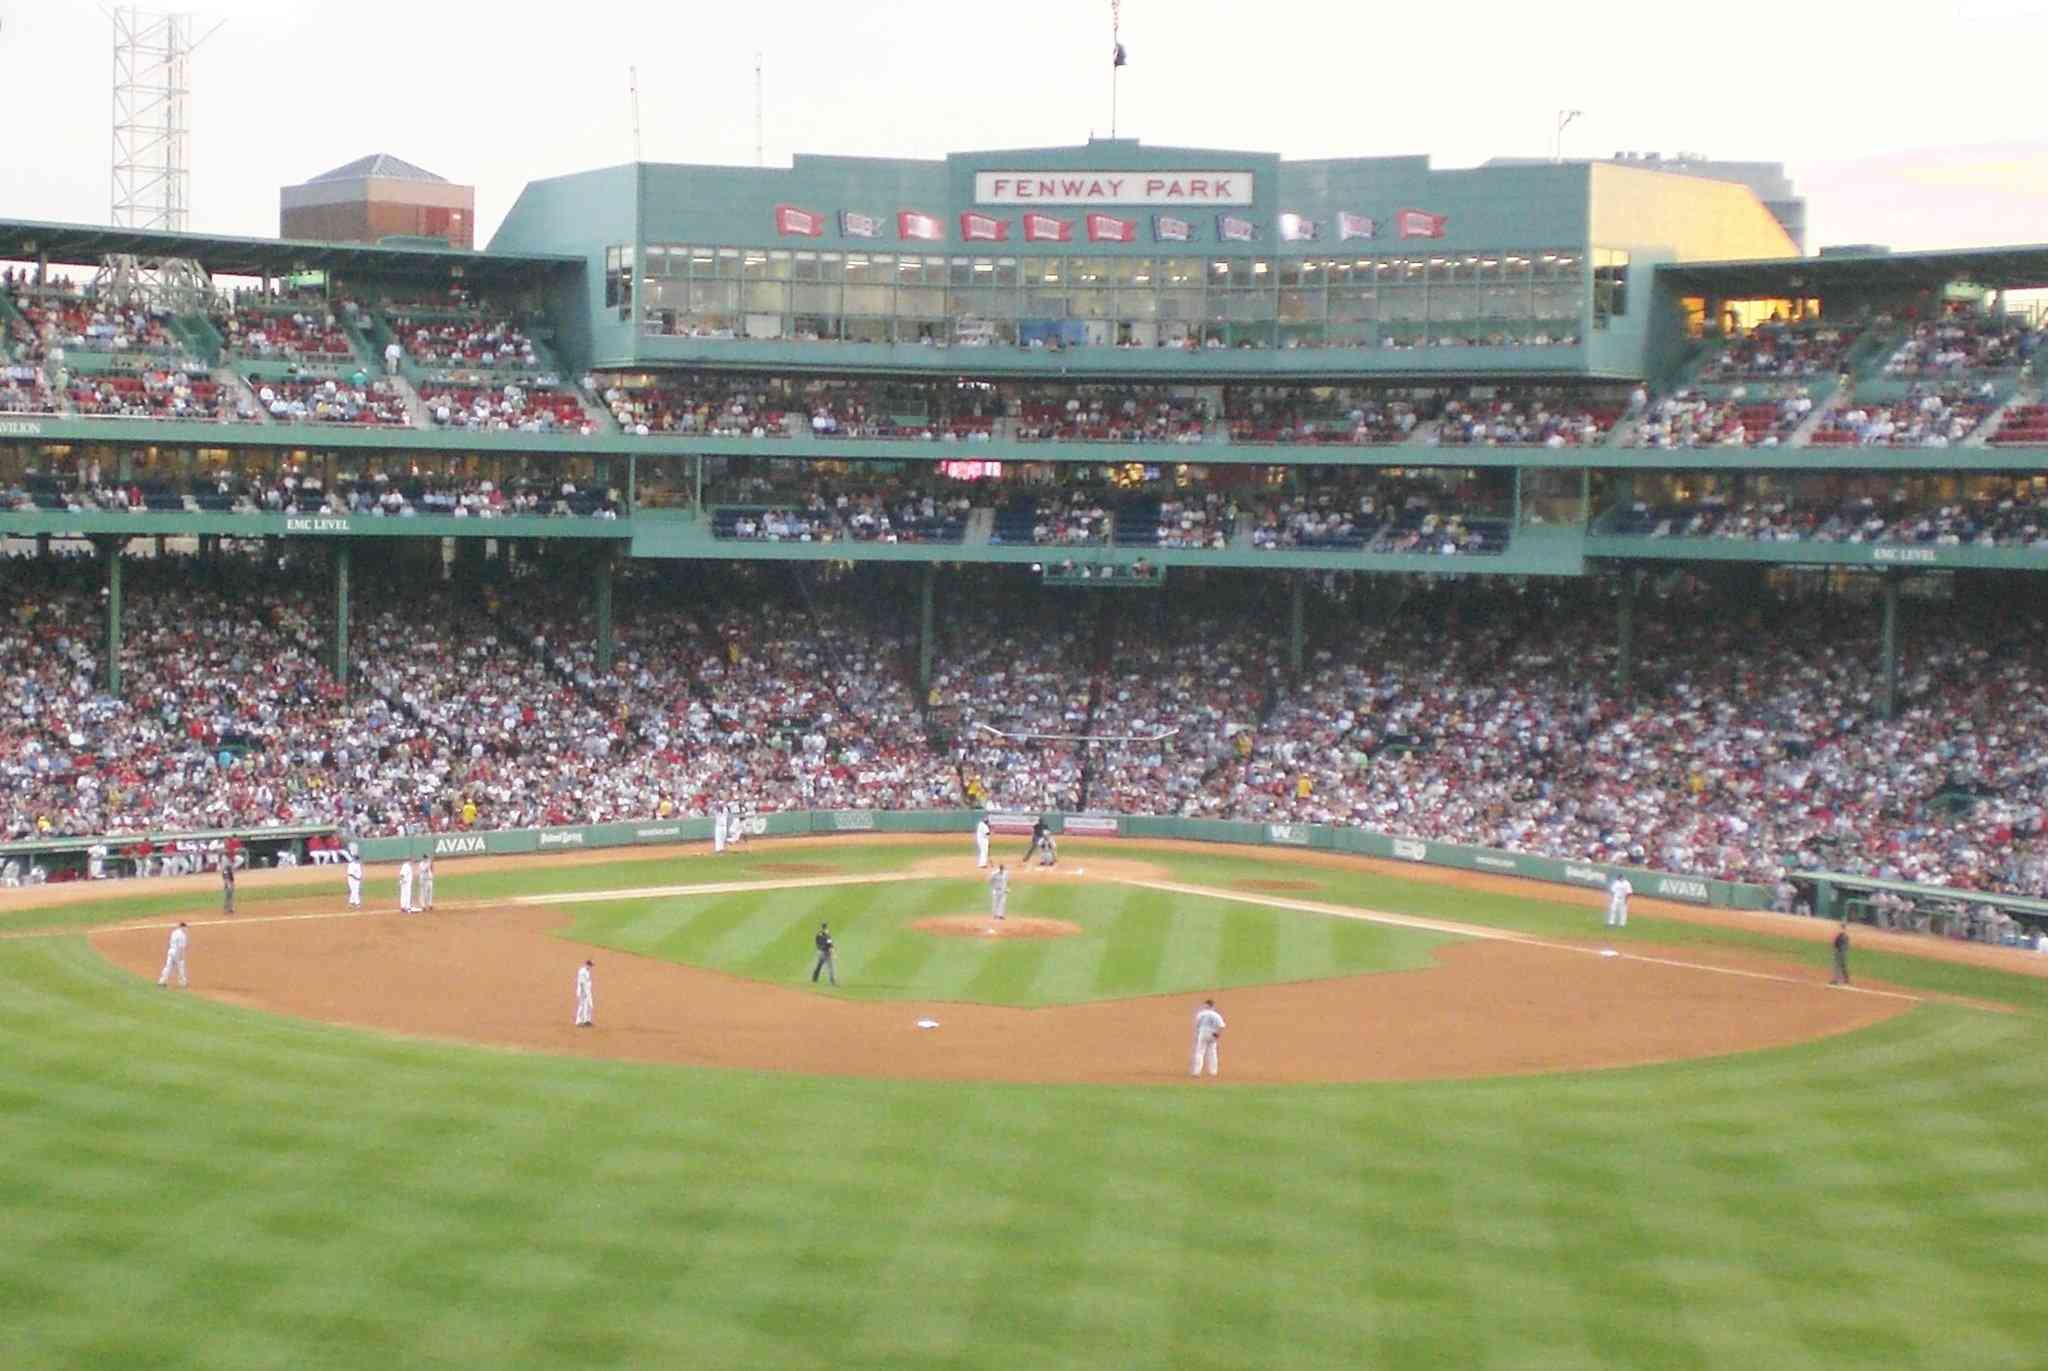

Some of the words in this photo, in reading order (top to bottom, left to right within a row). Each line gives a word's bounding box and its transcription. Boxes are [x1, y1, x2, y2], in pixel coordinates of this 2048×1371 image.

[993, 179, 1125, 198] FENWAY
[1145, 179, 1233, 198] PARK
[0, 422, 41, 433] VILION
[287, 519, 312, 530] EMC
[314, 519, 351, 530] LEVEL
[435, 836, 487, 853] AVAYA
[1658, 879, 1709, 898] AVAYA
